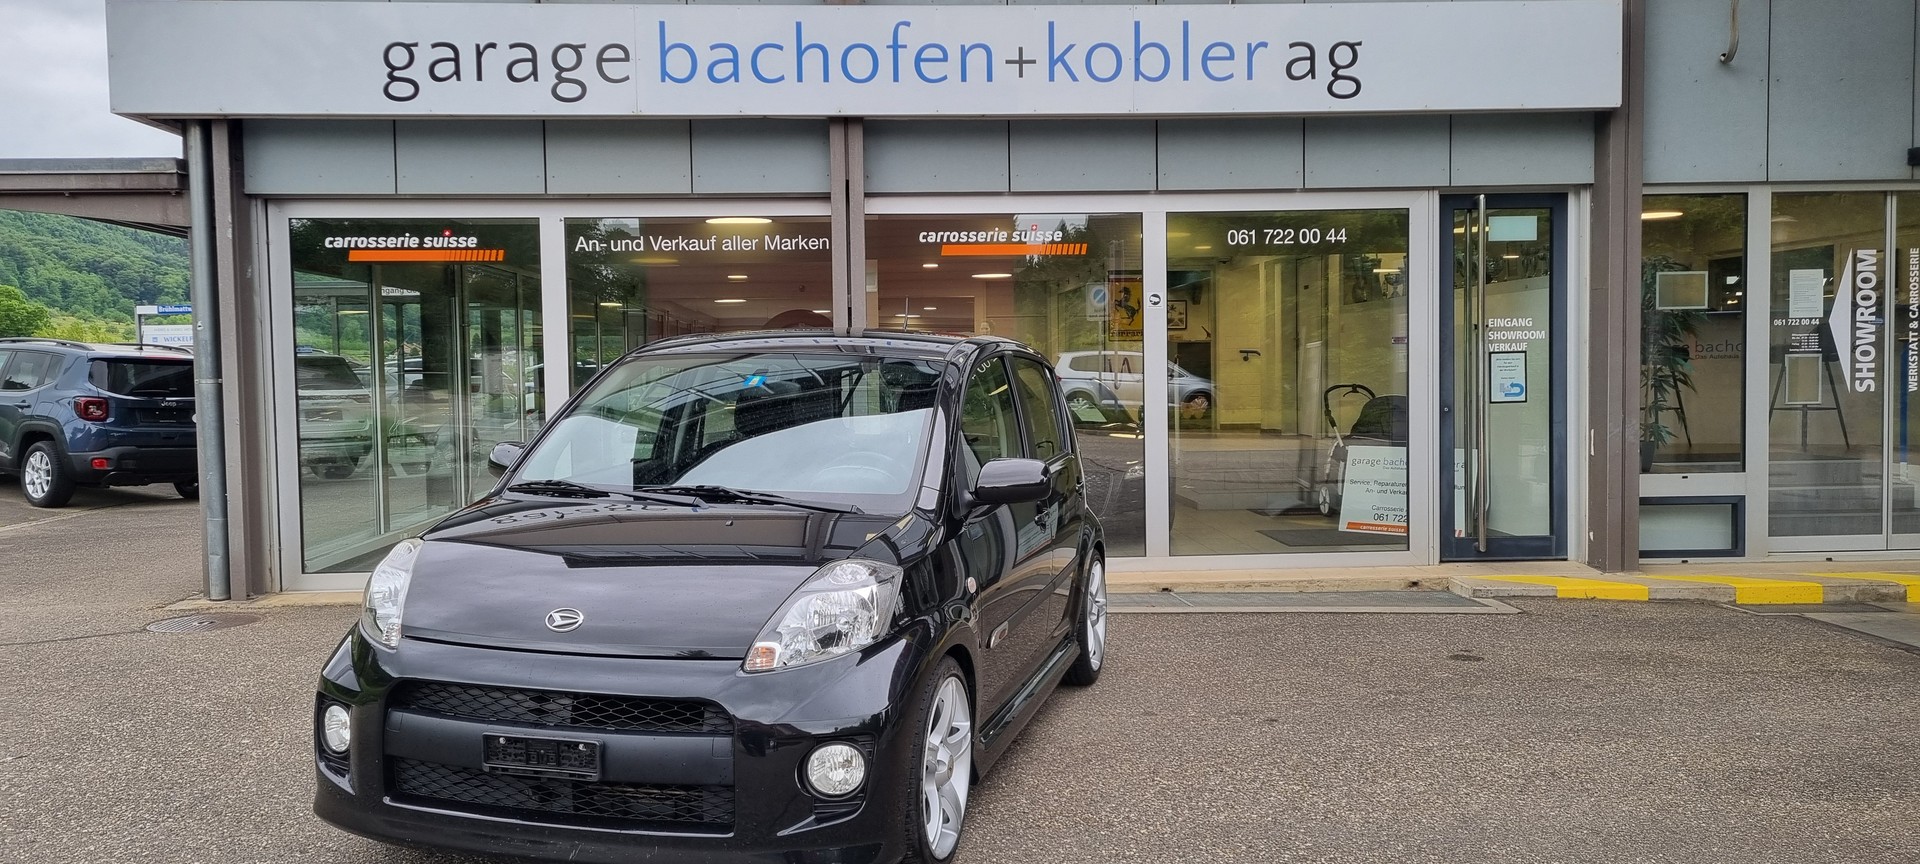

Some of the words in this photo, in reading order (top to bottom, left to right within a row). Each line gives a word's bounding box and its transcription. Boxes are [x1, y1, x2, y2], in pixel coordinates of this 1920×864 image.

[383, 40, 631, 104] garage
[1285, 40, 1363, 100] ag
[918, 226, 1008, 243] carrosserie
[1011, 227, 1064, 243] suisse
[1227, 229, 1257, 245] 061
[1263, 228, 1295, 245] 722
[1299, 228, 1321, 244] 00
[1325, 227, 1348, 244] 44
[324, 232, 420, 249] carrosserie
[423, 233, 479, 249] suisse
[574, 235, 607, 252] An-
[610, 236, 645, 252] und
[649, 234, 717, 252] Verkauf
[722, 234, 760, 251] aller
[764, 234, 831, 251] Marken
[1909, 247, 1920, 319] CARROSSERIE
[1487, 317, 1533, 328] EINGANG
[1773, 318, 1786, 326] 061
[1787, 318, 1800, 326] 722
[1800, 318, 1811, 326] 00
[1811, 318, 1820, 326] 44
[1854, 249, 1878, 393] SHOWROOM
[1908, 320, 1919, 330] &
[1487, 330, 1546, 341] SHOWROOM
[1488, 342, 1529, 352] VERKAUF
[1908, 330, 1919, 393] WERKSTATT
[161, 400, 177, 408] Jeep
[1351, 457, 1381, 468] garage
[1349, 478, 1373, 487] Service,
[1371, 504, 1405, 513] Carrosserie
[1373, 512, 1389, 522] 061
